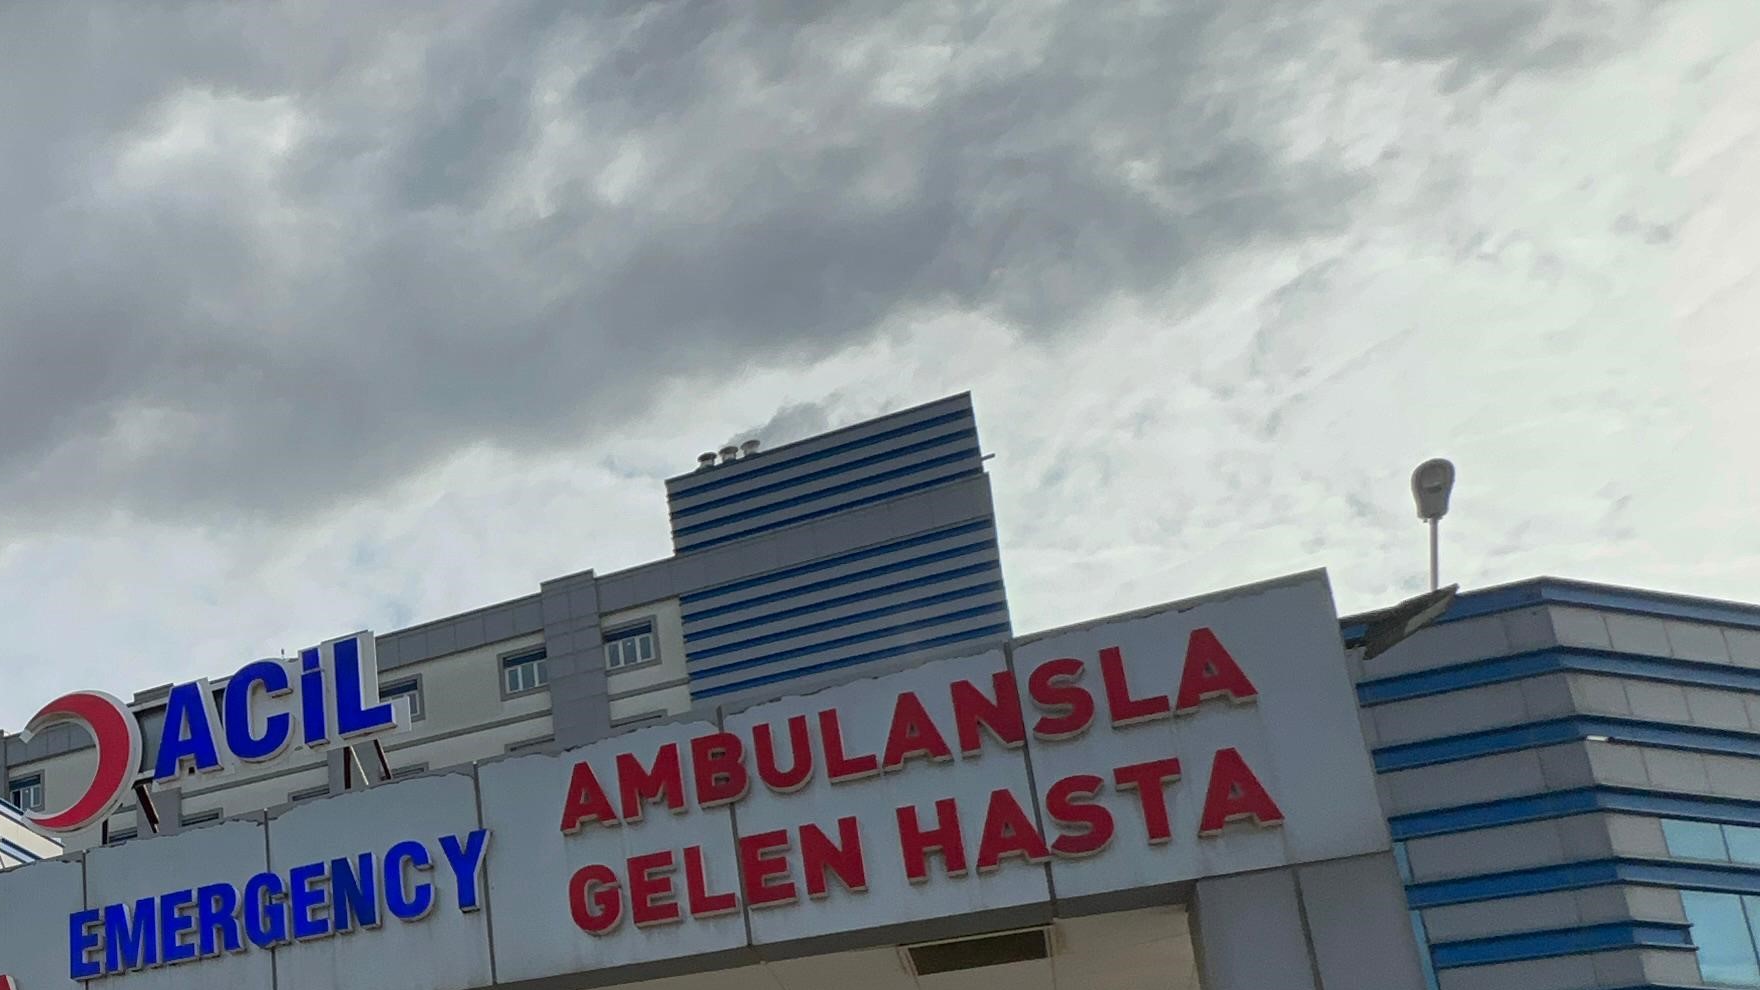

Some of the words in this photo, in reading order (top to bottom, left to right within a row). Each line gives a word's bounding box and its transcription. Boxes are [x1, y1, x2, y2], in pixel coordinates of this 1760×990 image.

[153, 633, 402, 784] ACİL
[560, 626, 1258, 835] AMBULANSLA
[69, 829, 492, 982] EMERGENCY
[568, 815, 868, 936] GELEN
[895, 747, 1285, 885] HASTA
